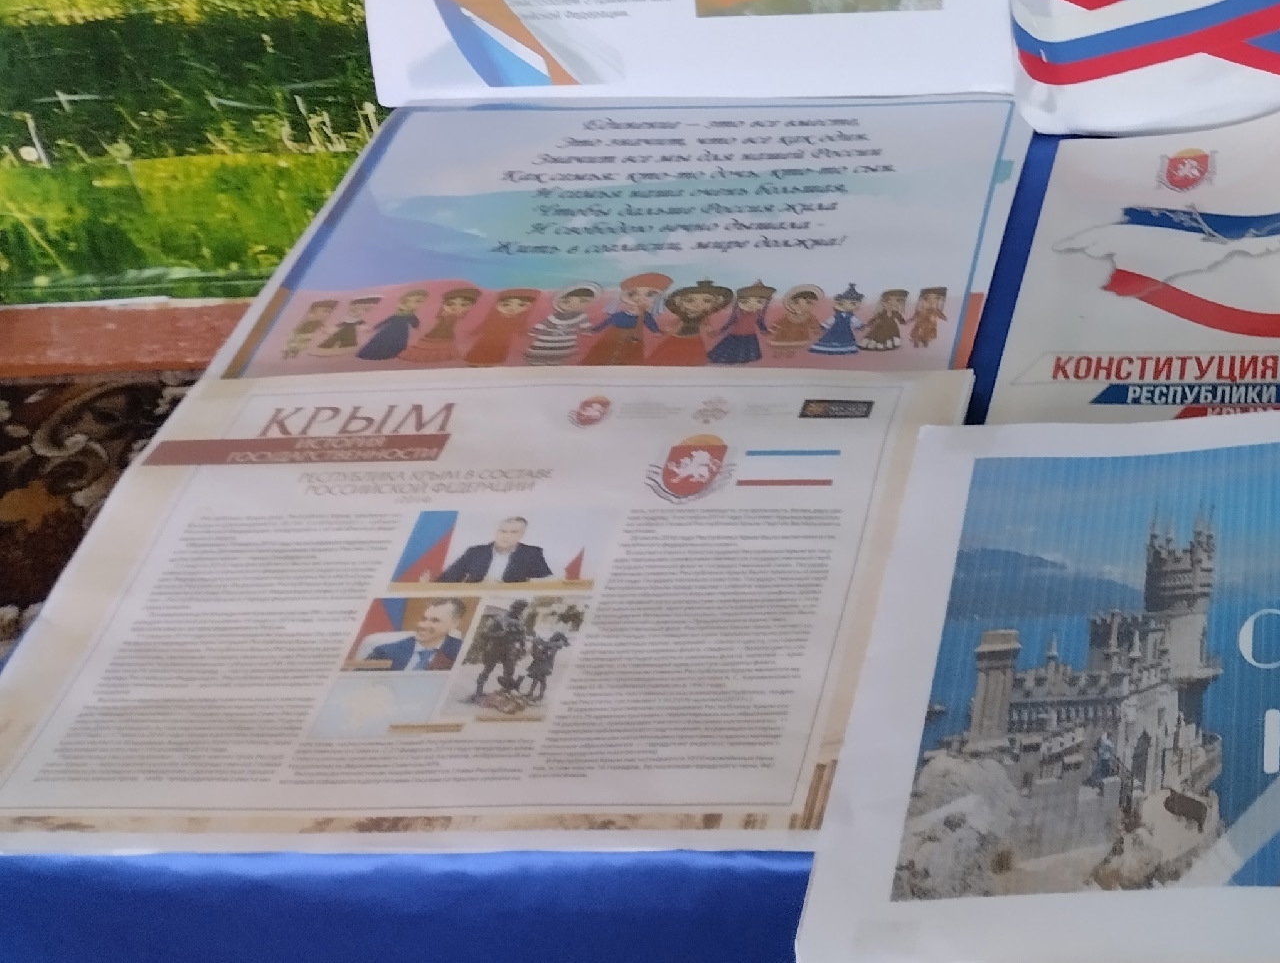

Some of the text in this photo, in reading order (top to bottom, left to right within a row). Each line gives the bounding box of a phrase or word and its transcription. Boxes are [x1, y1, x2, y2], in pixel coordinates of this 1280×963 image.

[1052, 355, 1280, 382] КОНСТИТУЦИЯ
[1127, 385, 1277, 404] РЕСПУБЛИКИ
[259, 402, 457, 437] КРЫМ
